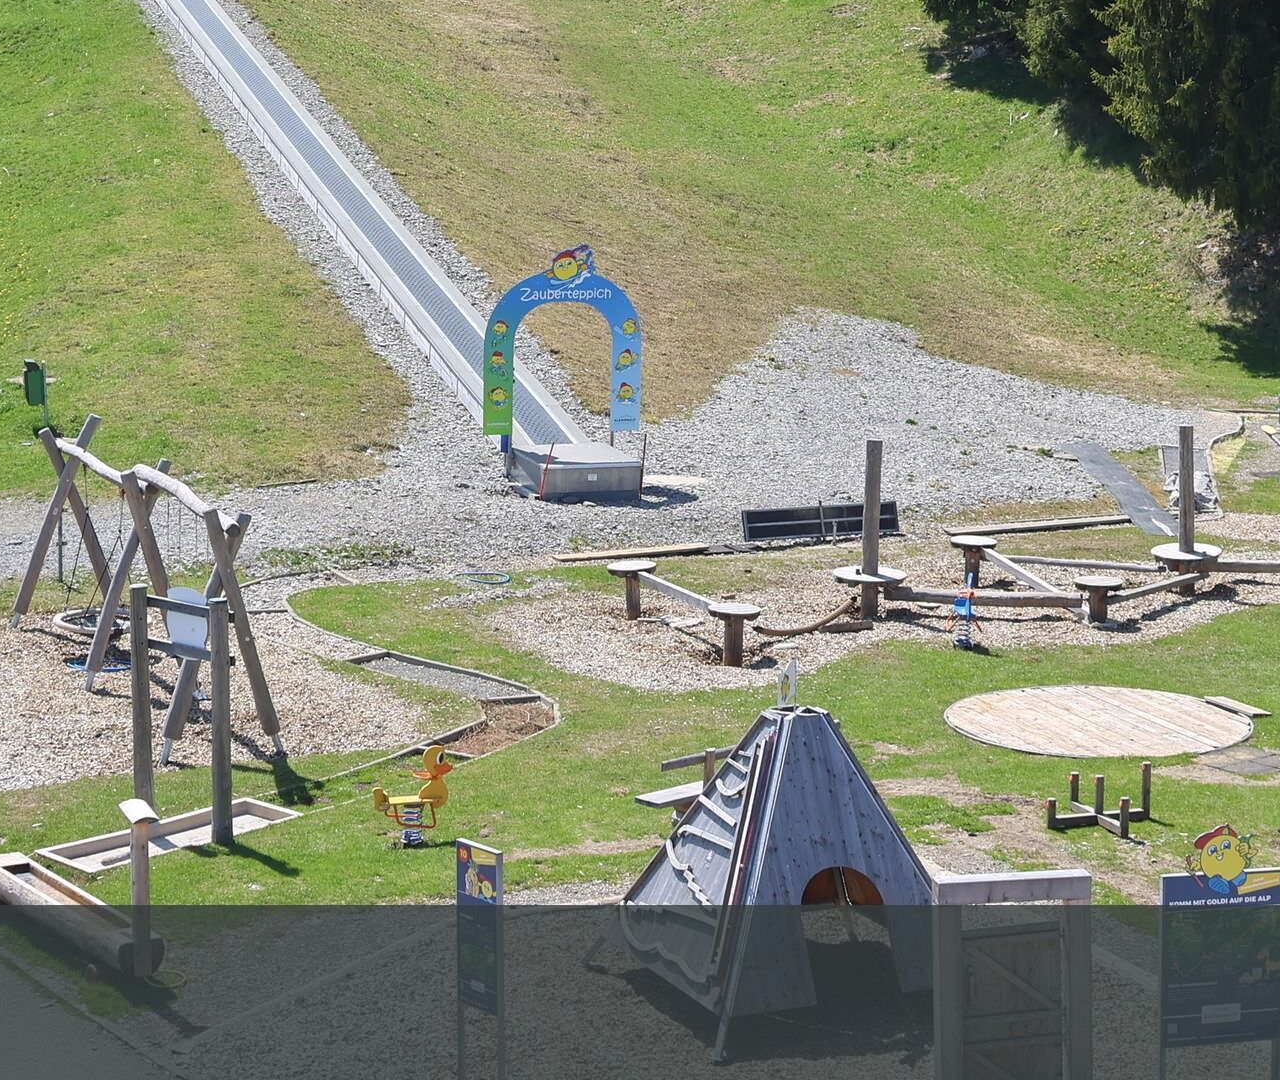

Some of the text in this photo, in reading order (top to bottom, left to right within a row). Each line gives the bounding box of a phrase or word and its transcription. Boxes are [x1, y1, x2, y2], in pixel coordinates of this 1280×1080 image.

[519, 287, 612, 302] Zauberteppich
[1229, 896, 1243, 904] AUF
[1244, 895, 1257, 903] DIE
[1257, 894, 1271, 902] ALP
